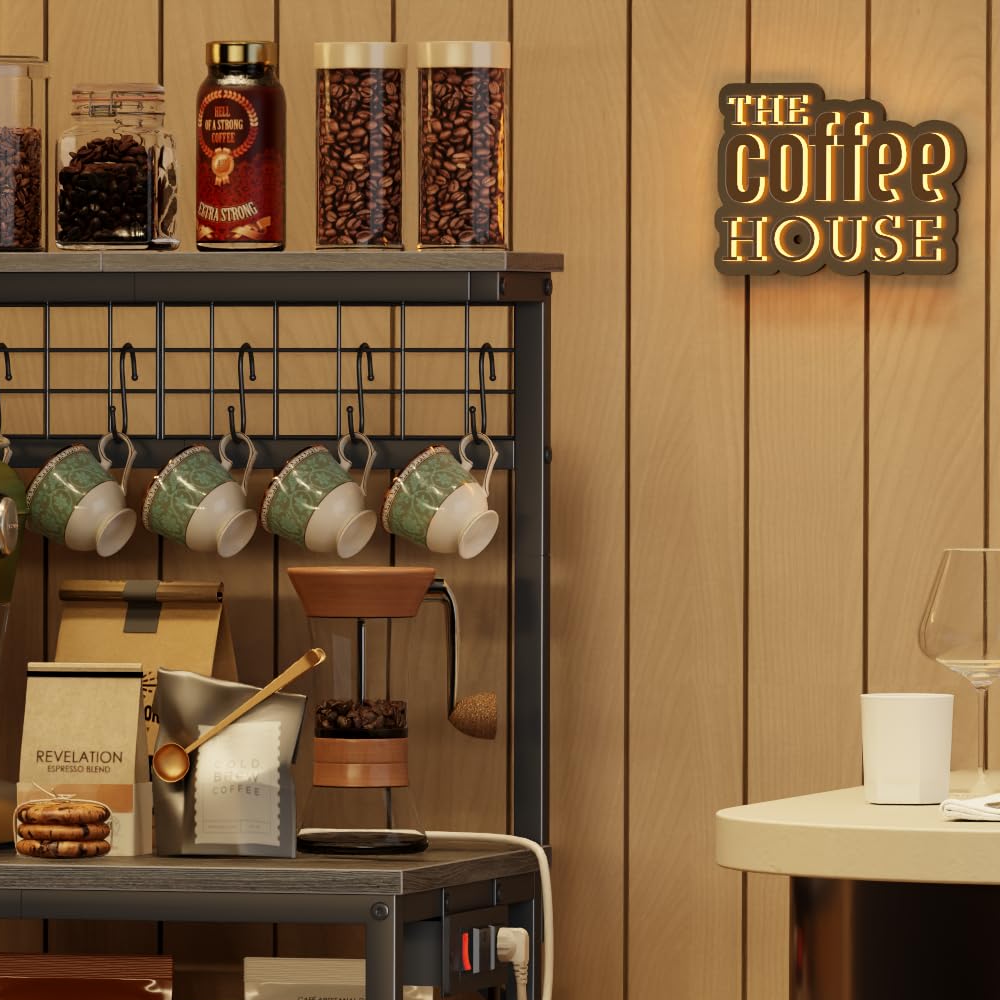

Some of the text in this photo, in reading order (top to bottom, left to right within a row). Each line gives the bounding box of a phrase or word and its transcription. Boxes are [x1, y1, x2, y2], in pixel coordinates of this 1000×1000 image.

[214, 105, 231, 118] HELL
[727, 95, 809, 126] THE
[217, 119, 244, 131] STRONG
[211, 132, 236, 144] COFFEE
[220, 201, 258, 222] STRONG
[721, 214, 944, 263] HOUSE
[36, 750, 123, 763] REVELATION
[47, 765, 111, 774] ESPRESSO BLEND
[212, 784, 261, 797] COFFEE
